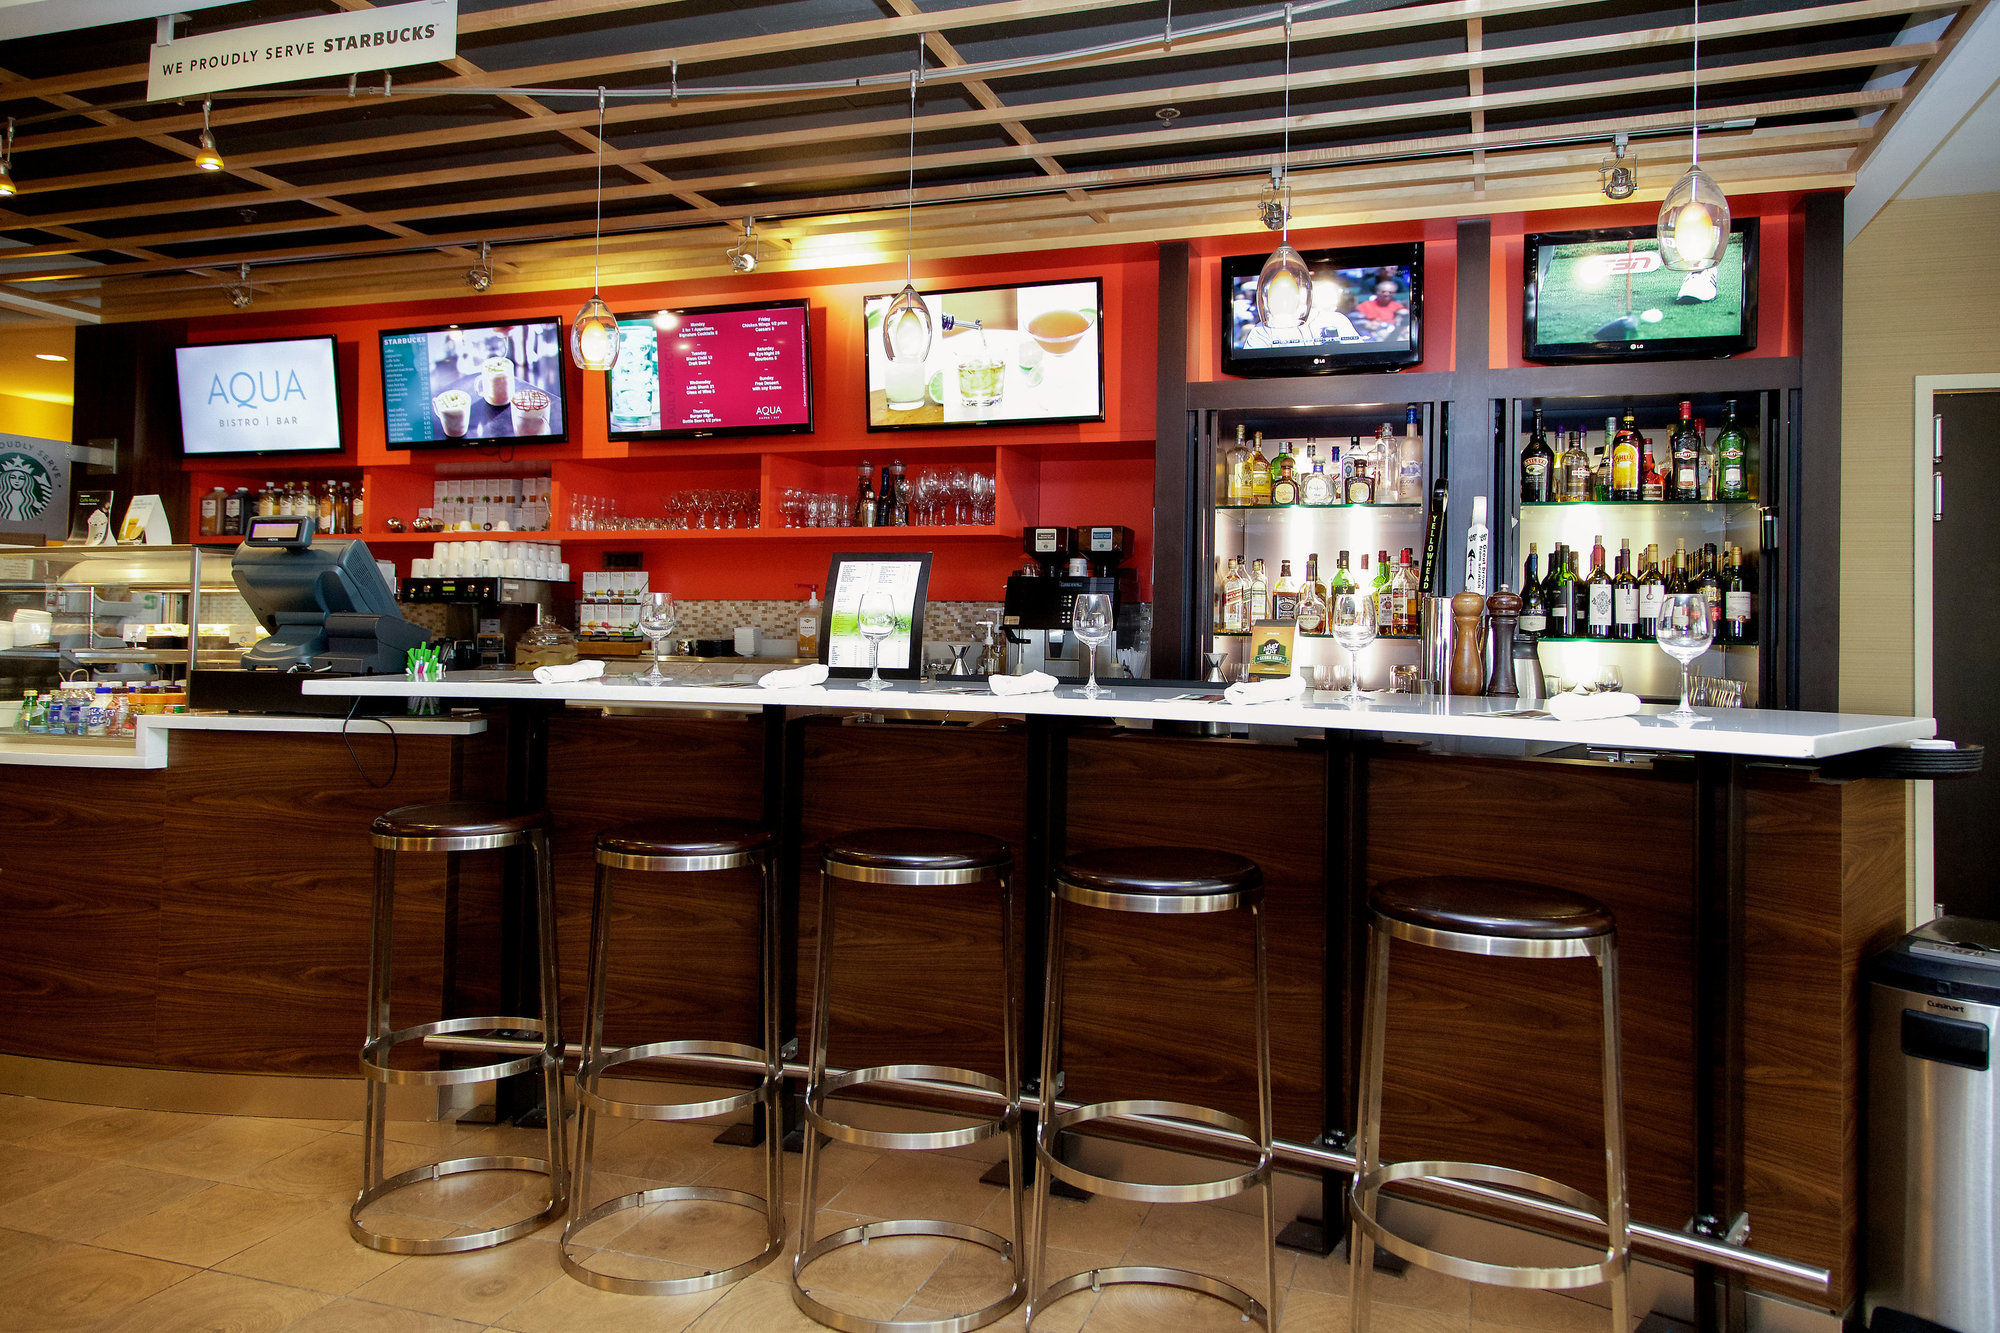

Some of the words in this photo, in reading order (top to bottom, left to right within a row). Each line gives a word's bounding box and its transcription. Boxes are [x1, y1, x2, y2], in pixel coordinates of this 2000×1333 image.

[162, 61, 184, 76] WE
[189, 50, 259, 72] PROUDLY
[265, 41, 316, 61] SERVE
[323, 23, 436, 54] STARBUCKS
[383, 335, 426, 346] STARBUCKS
[207, 368, 308, 410] AQUA
[755, 405, 783, 416] AQUA
[219, 418, 260, 428] BISTRO
[276, 416, 299, 425] BAR
[1422, 514, 1438, 590] YELLOWHEAD
[1927, 1000, 1964, 1012] Cuisinart
